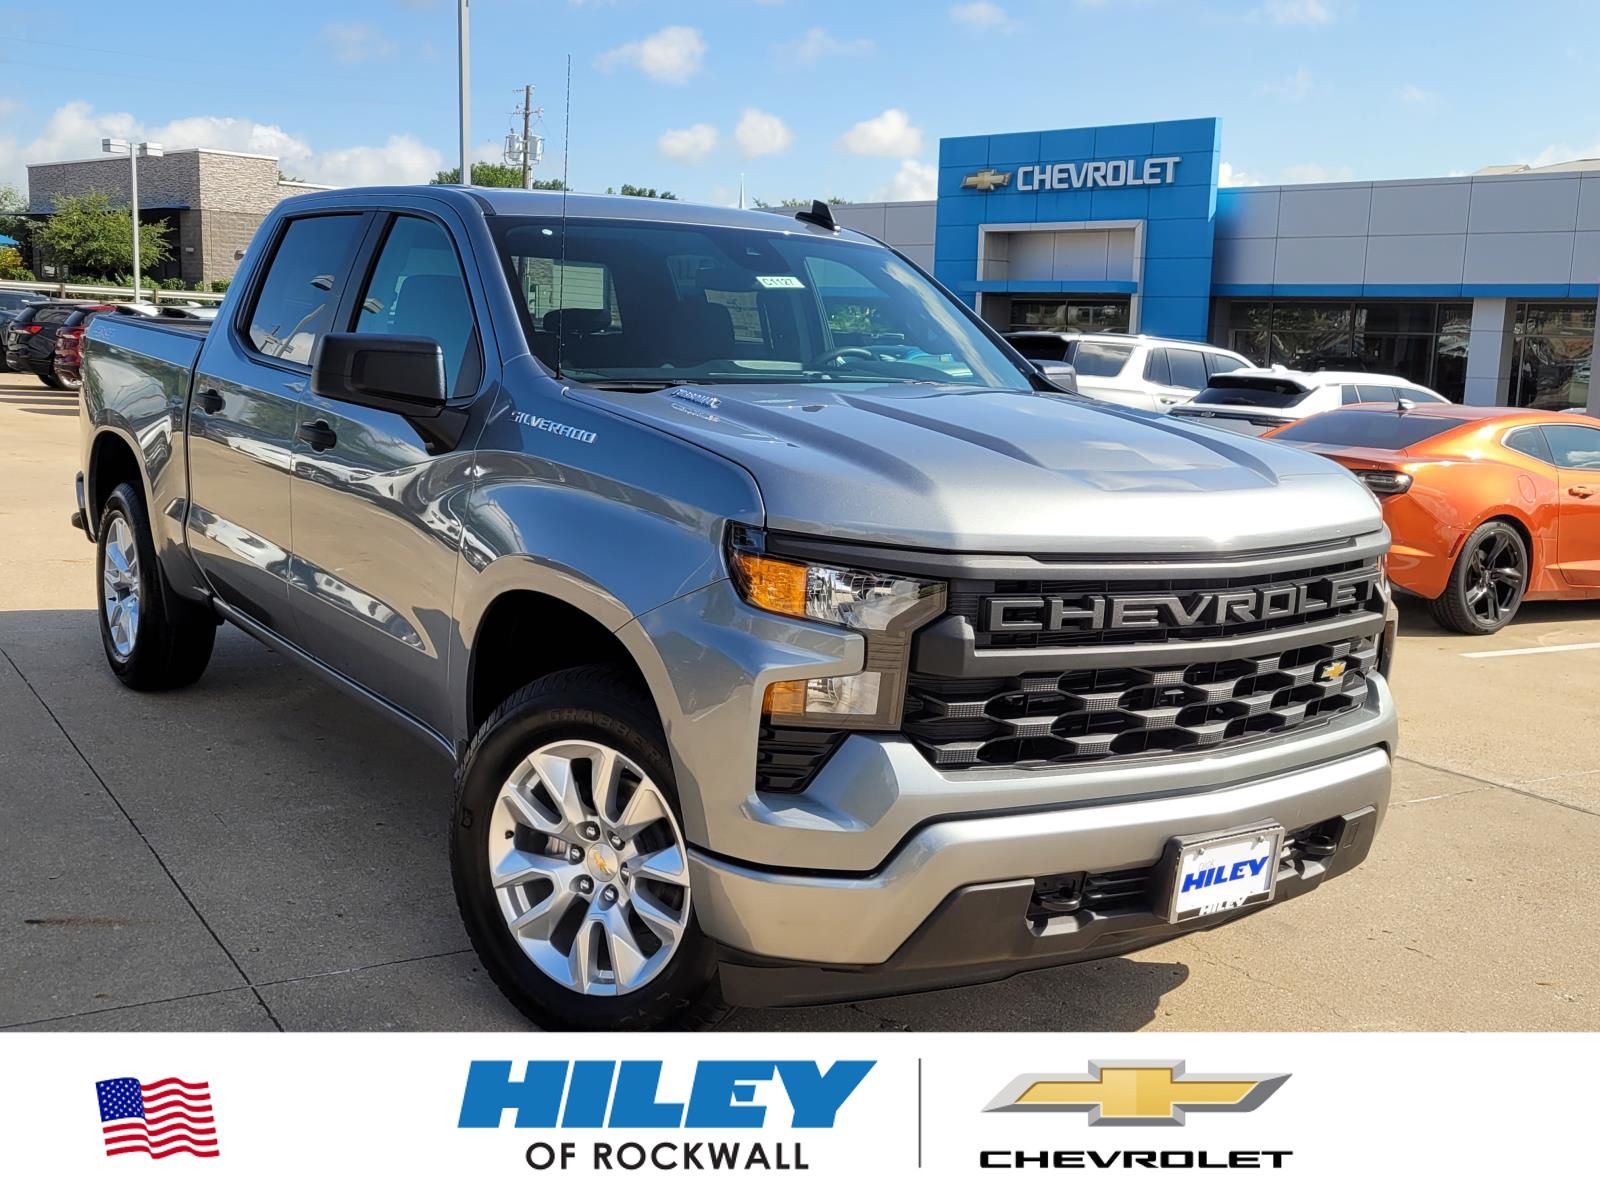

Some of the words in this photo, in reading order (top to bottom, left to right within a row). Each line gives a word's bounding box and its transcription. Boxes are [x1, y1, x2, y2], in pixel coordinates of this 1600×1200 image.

[1017, 156, 1183, 191] CHEVROLET
[512, 411, 597, 443] SILVERADO
[988, 571, 1382, 631] CHEVROLET
[550, 708, 663, 761] GRABBER
[1181, 856, 1269, 893] HILEY
